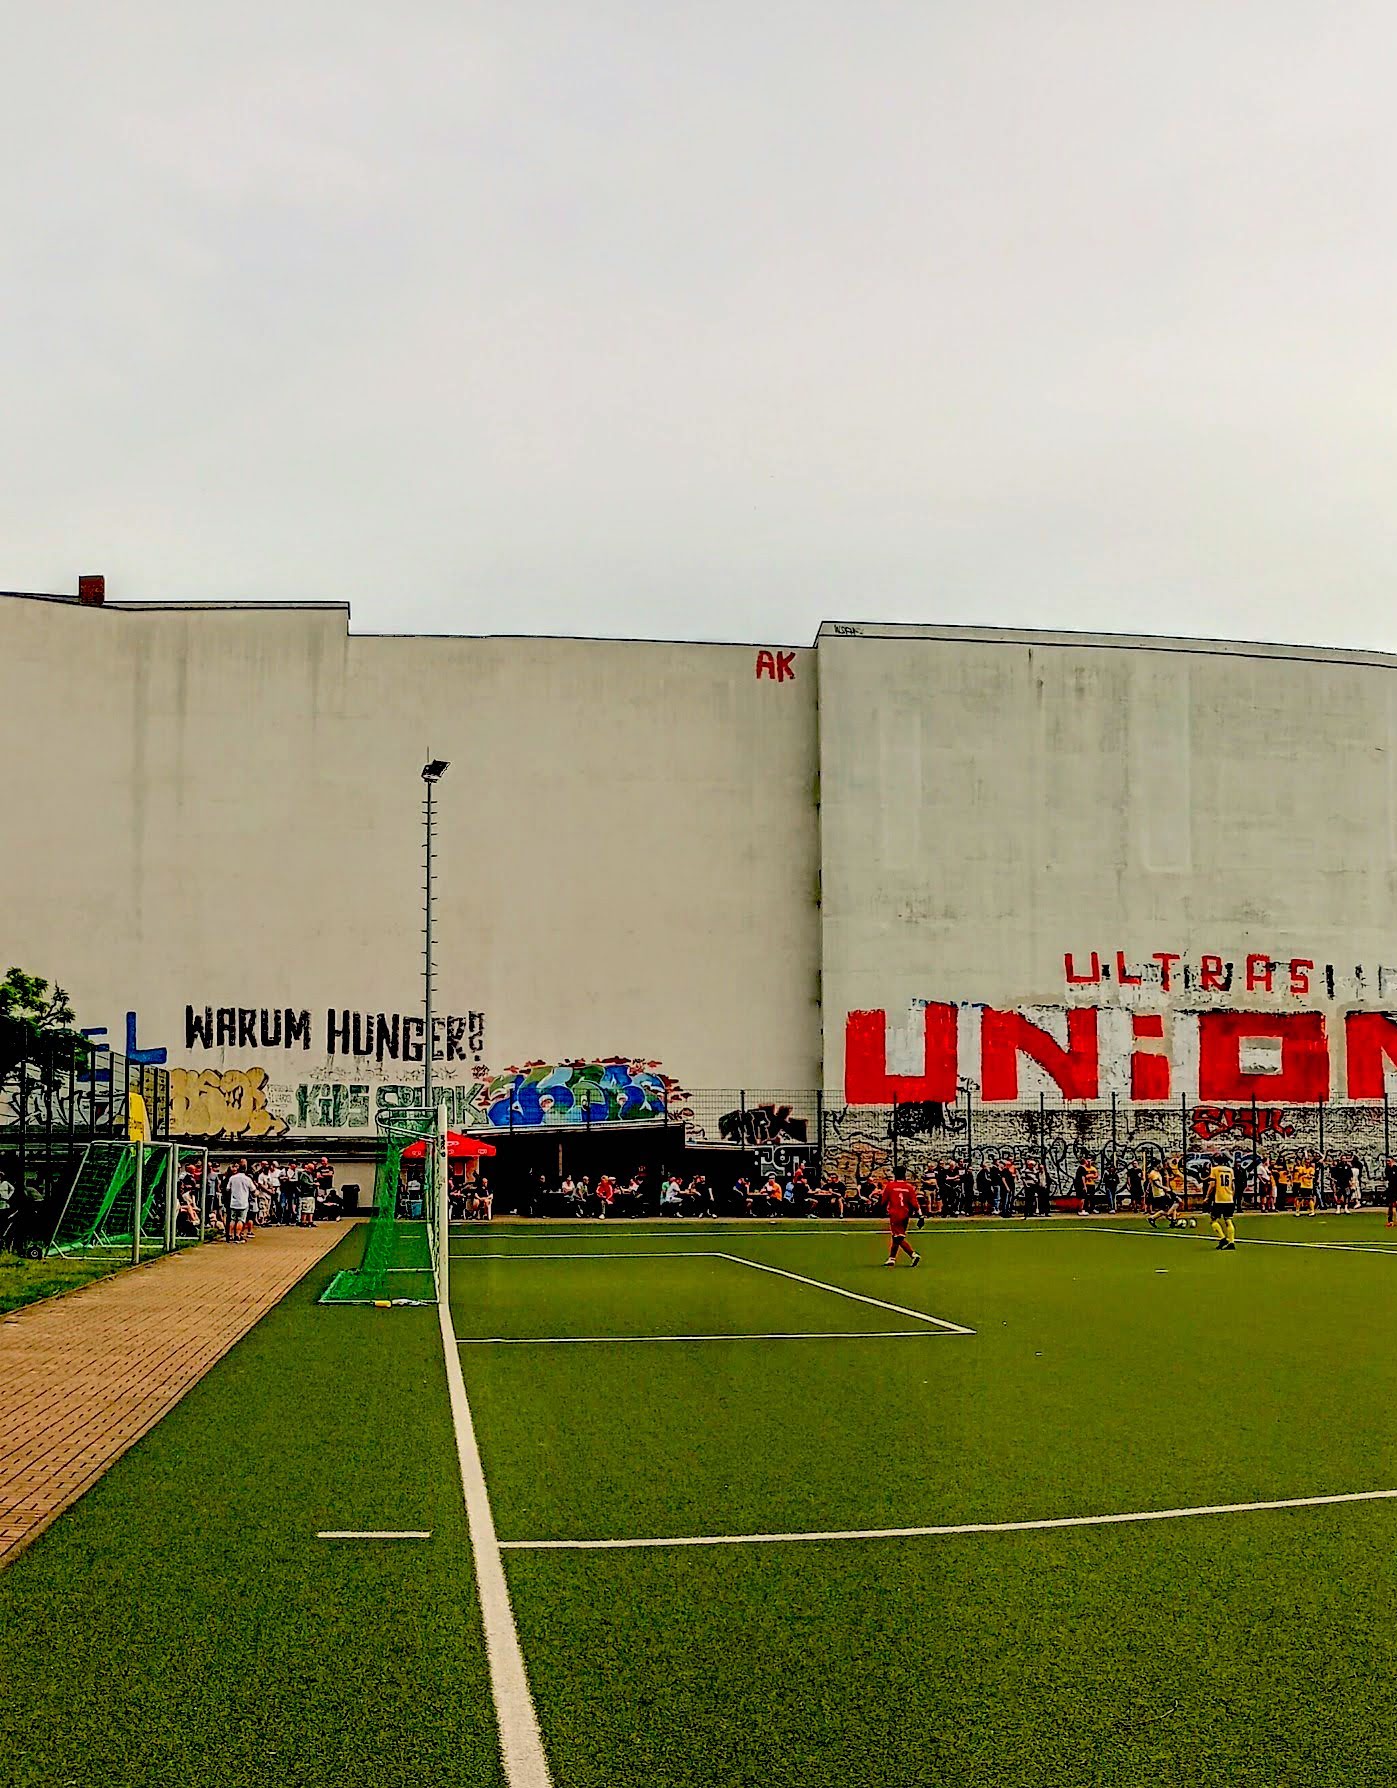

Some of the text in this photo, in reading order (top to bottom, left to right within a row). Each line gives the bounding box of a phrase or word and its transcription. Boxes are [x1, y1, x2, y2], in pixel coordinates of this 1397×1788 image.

[756, 650, 795, 682] AK
[1064, 951, 1314, 994] ULTRAS
[185, 1004, 311, 1049] WARUM
[1219, 1173, 1230, 1187] 16
